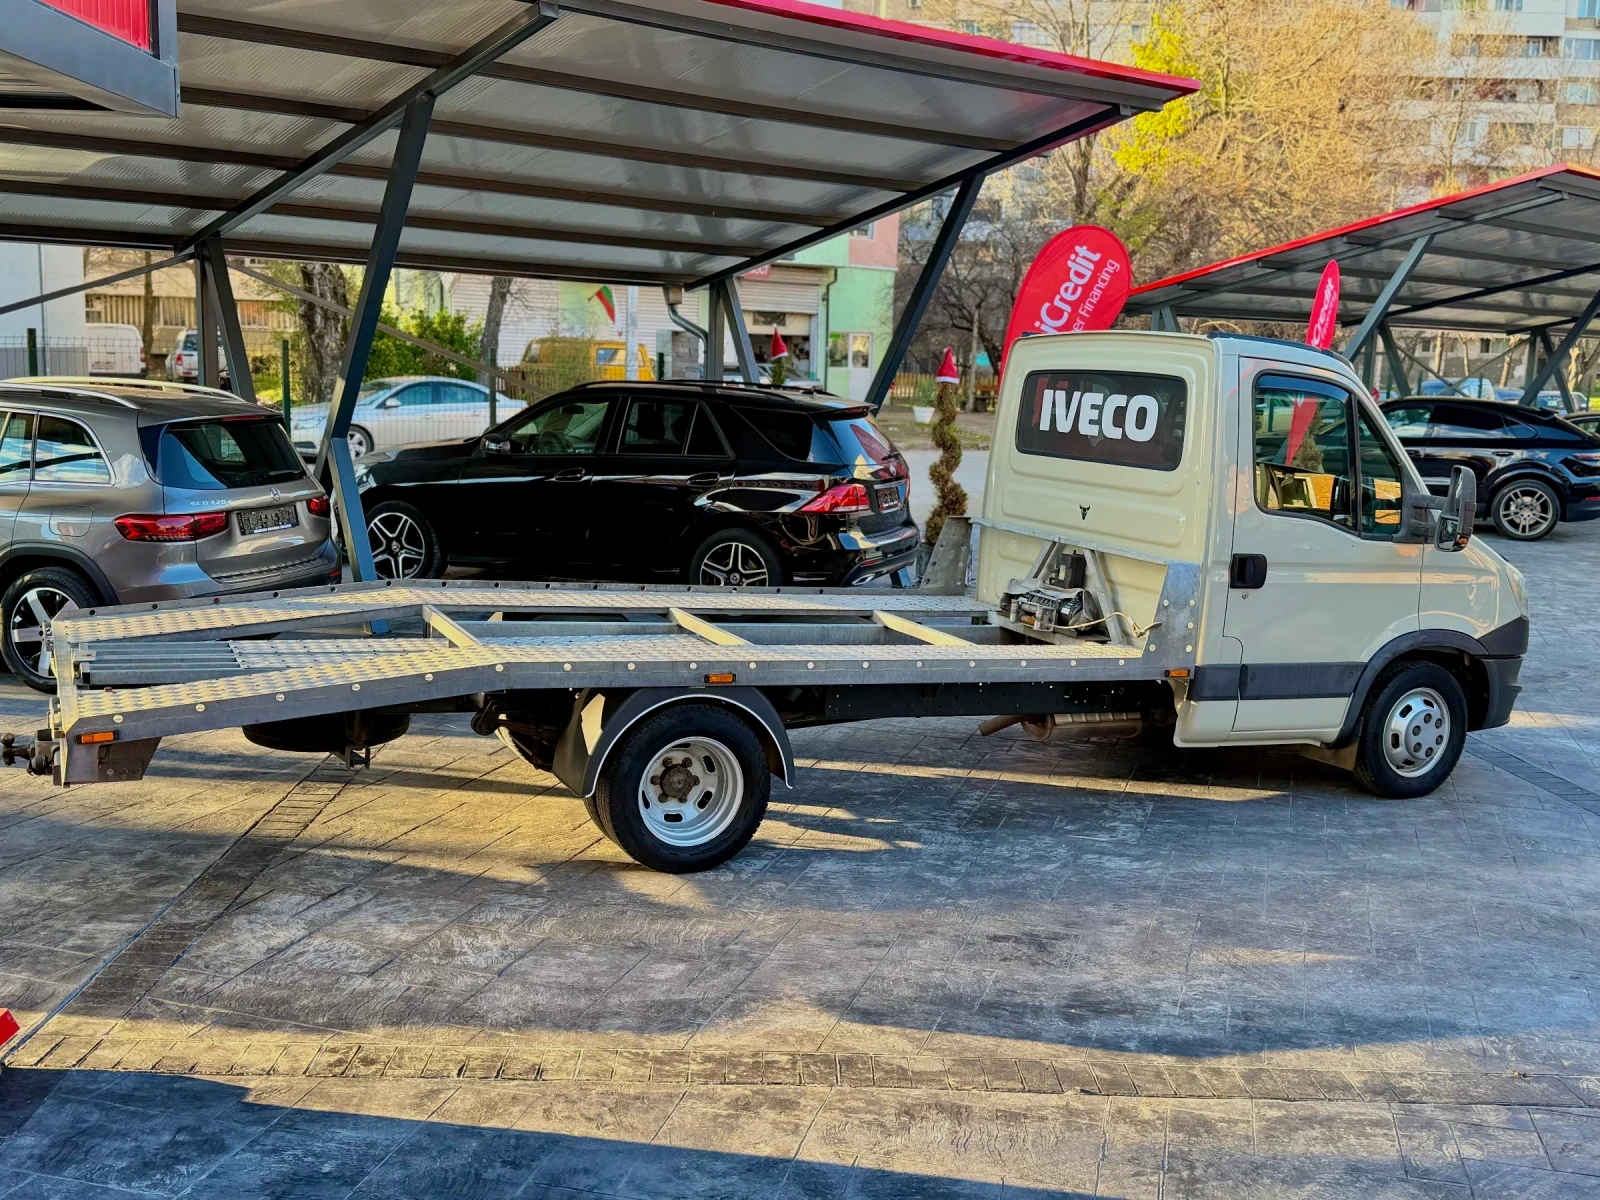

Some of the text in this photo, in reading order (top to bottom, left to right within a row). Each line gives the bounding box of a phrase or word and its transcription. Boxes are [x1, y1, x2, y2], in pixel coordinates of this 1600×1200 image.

[1034, 245, 1101, 334] iCredit
[1078, 259, 1120, 317] Financing
[1039, 389, 1159, 442] IVECO
